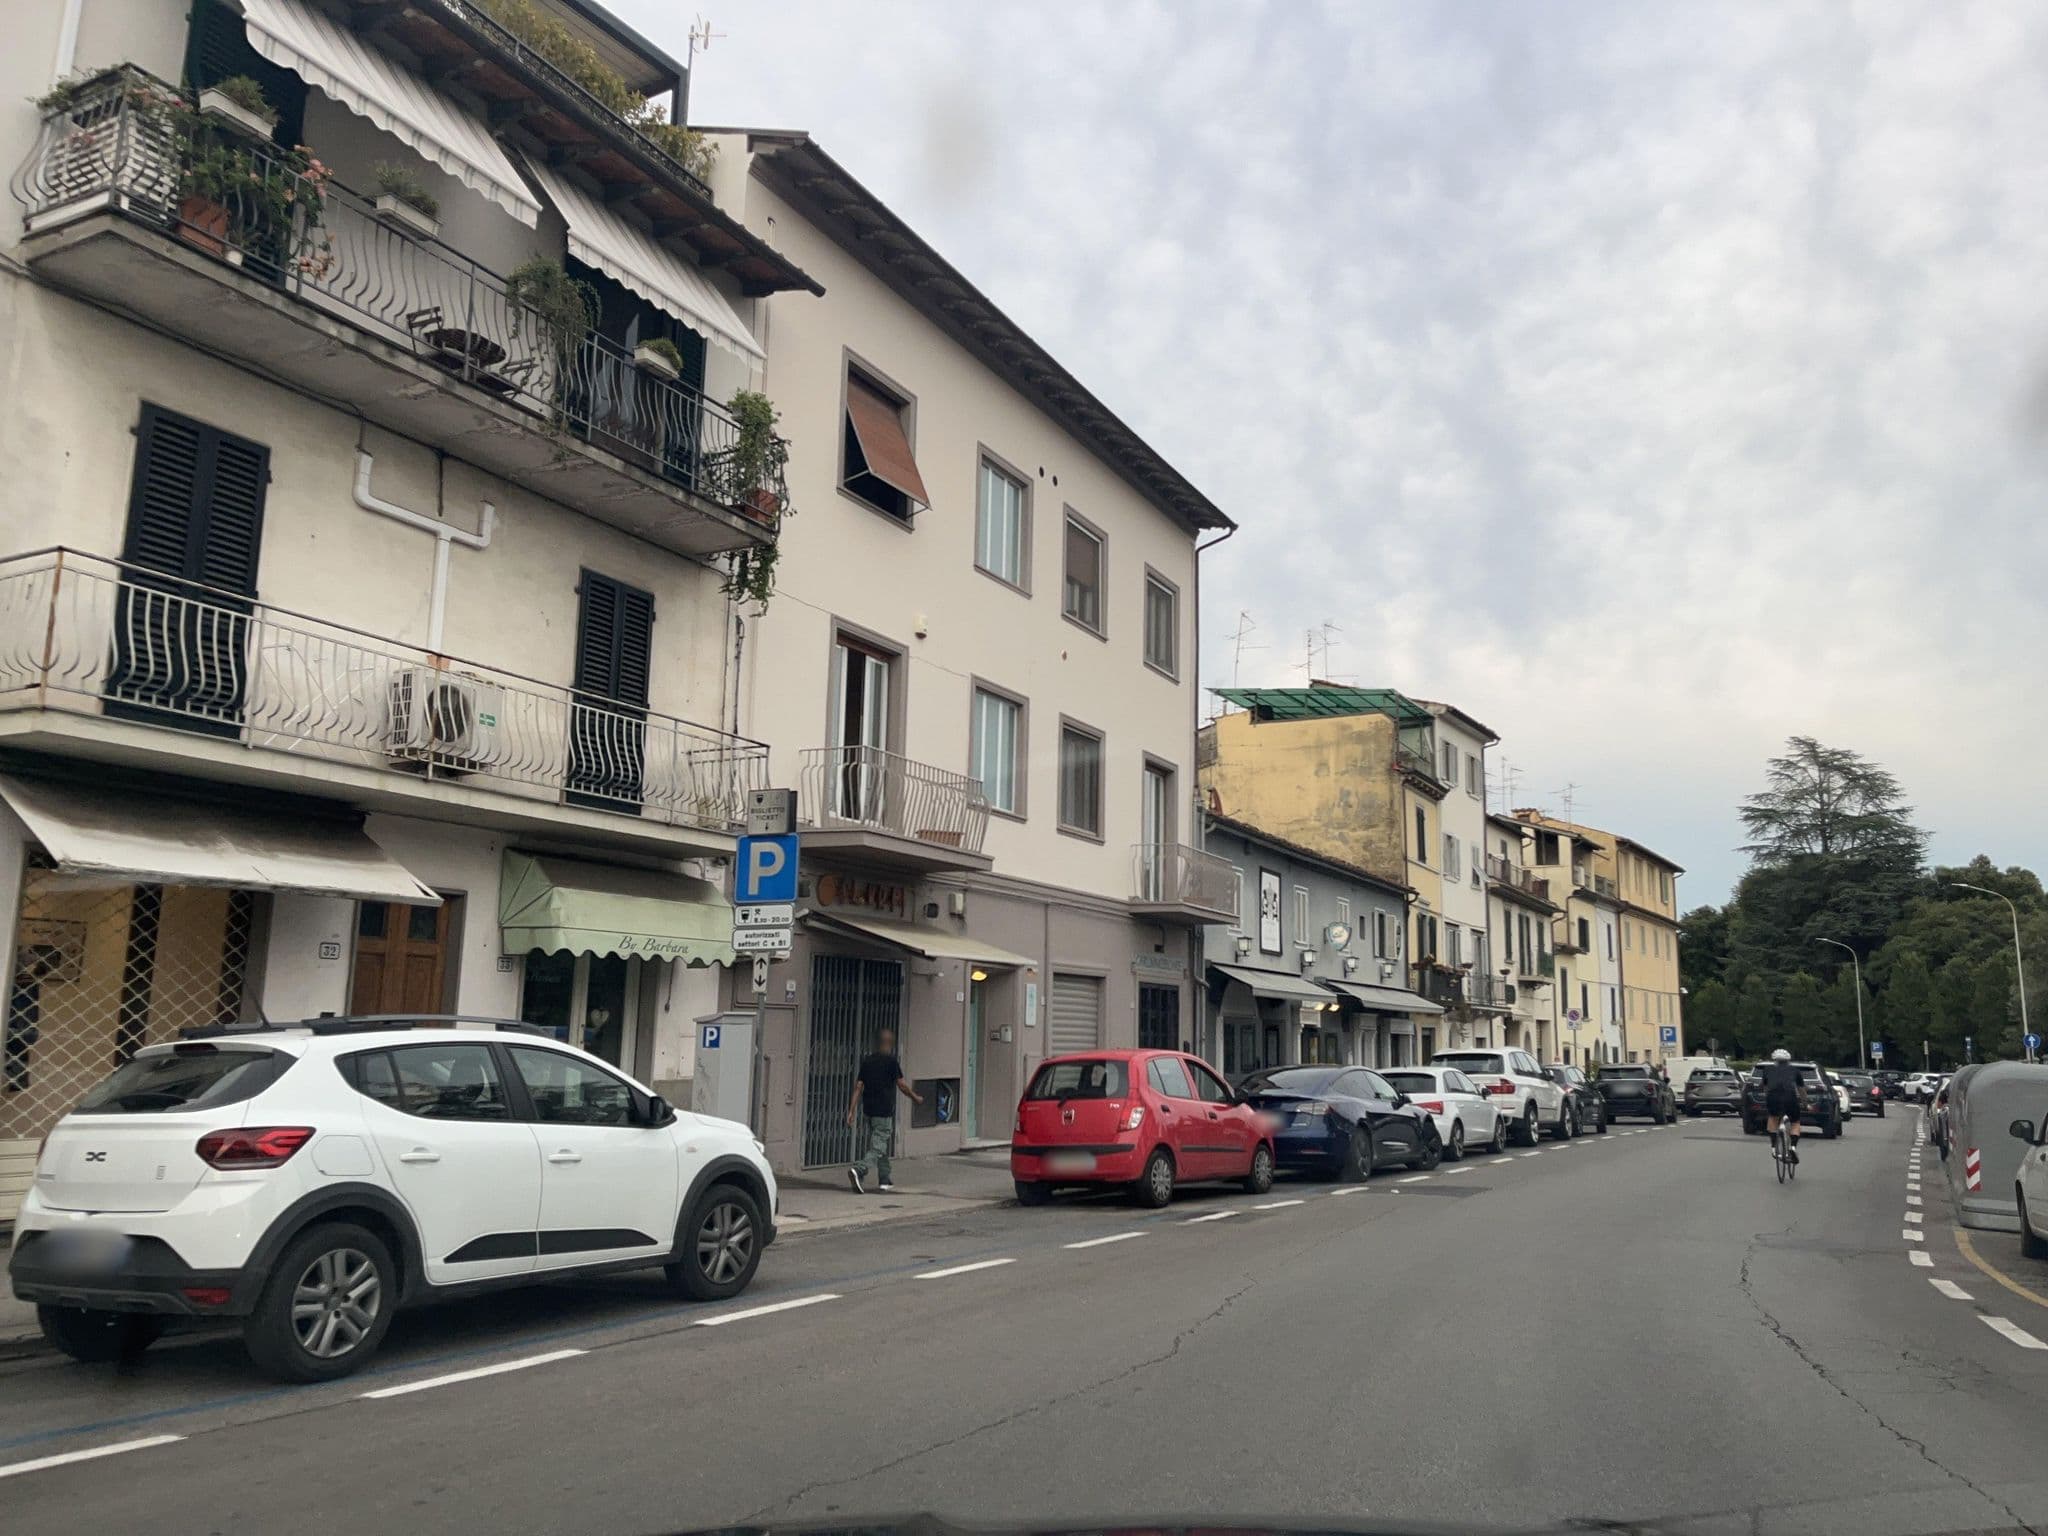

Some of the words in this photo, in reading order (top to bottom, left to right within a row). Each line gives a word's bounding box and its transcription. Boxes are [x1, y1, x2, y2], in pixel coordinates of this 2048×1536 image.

[748, 841, 785, 896] P
[323, 945, 336, 957] 32
[643, 938, 689, 954] Barbara
[705, 1027, 718, 1048] P
[1662, 1027, 1673, 1041] P
